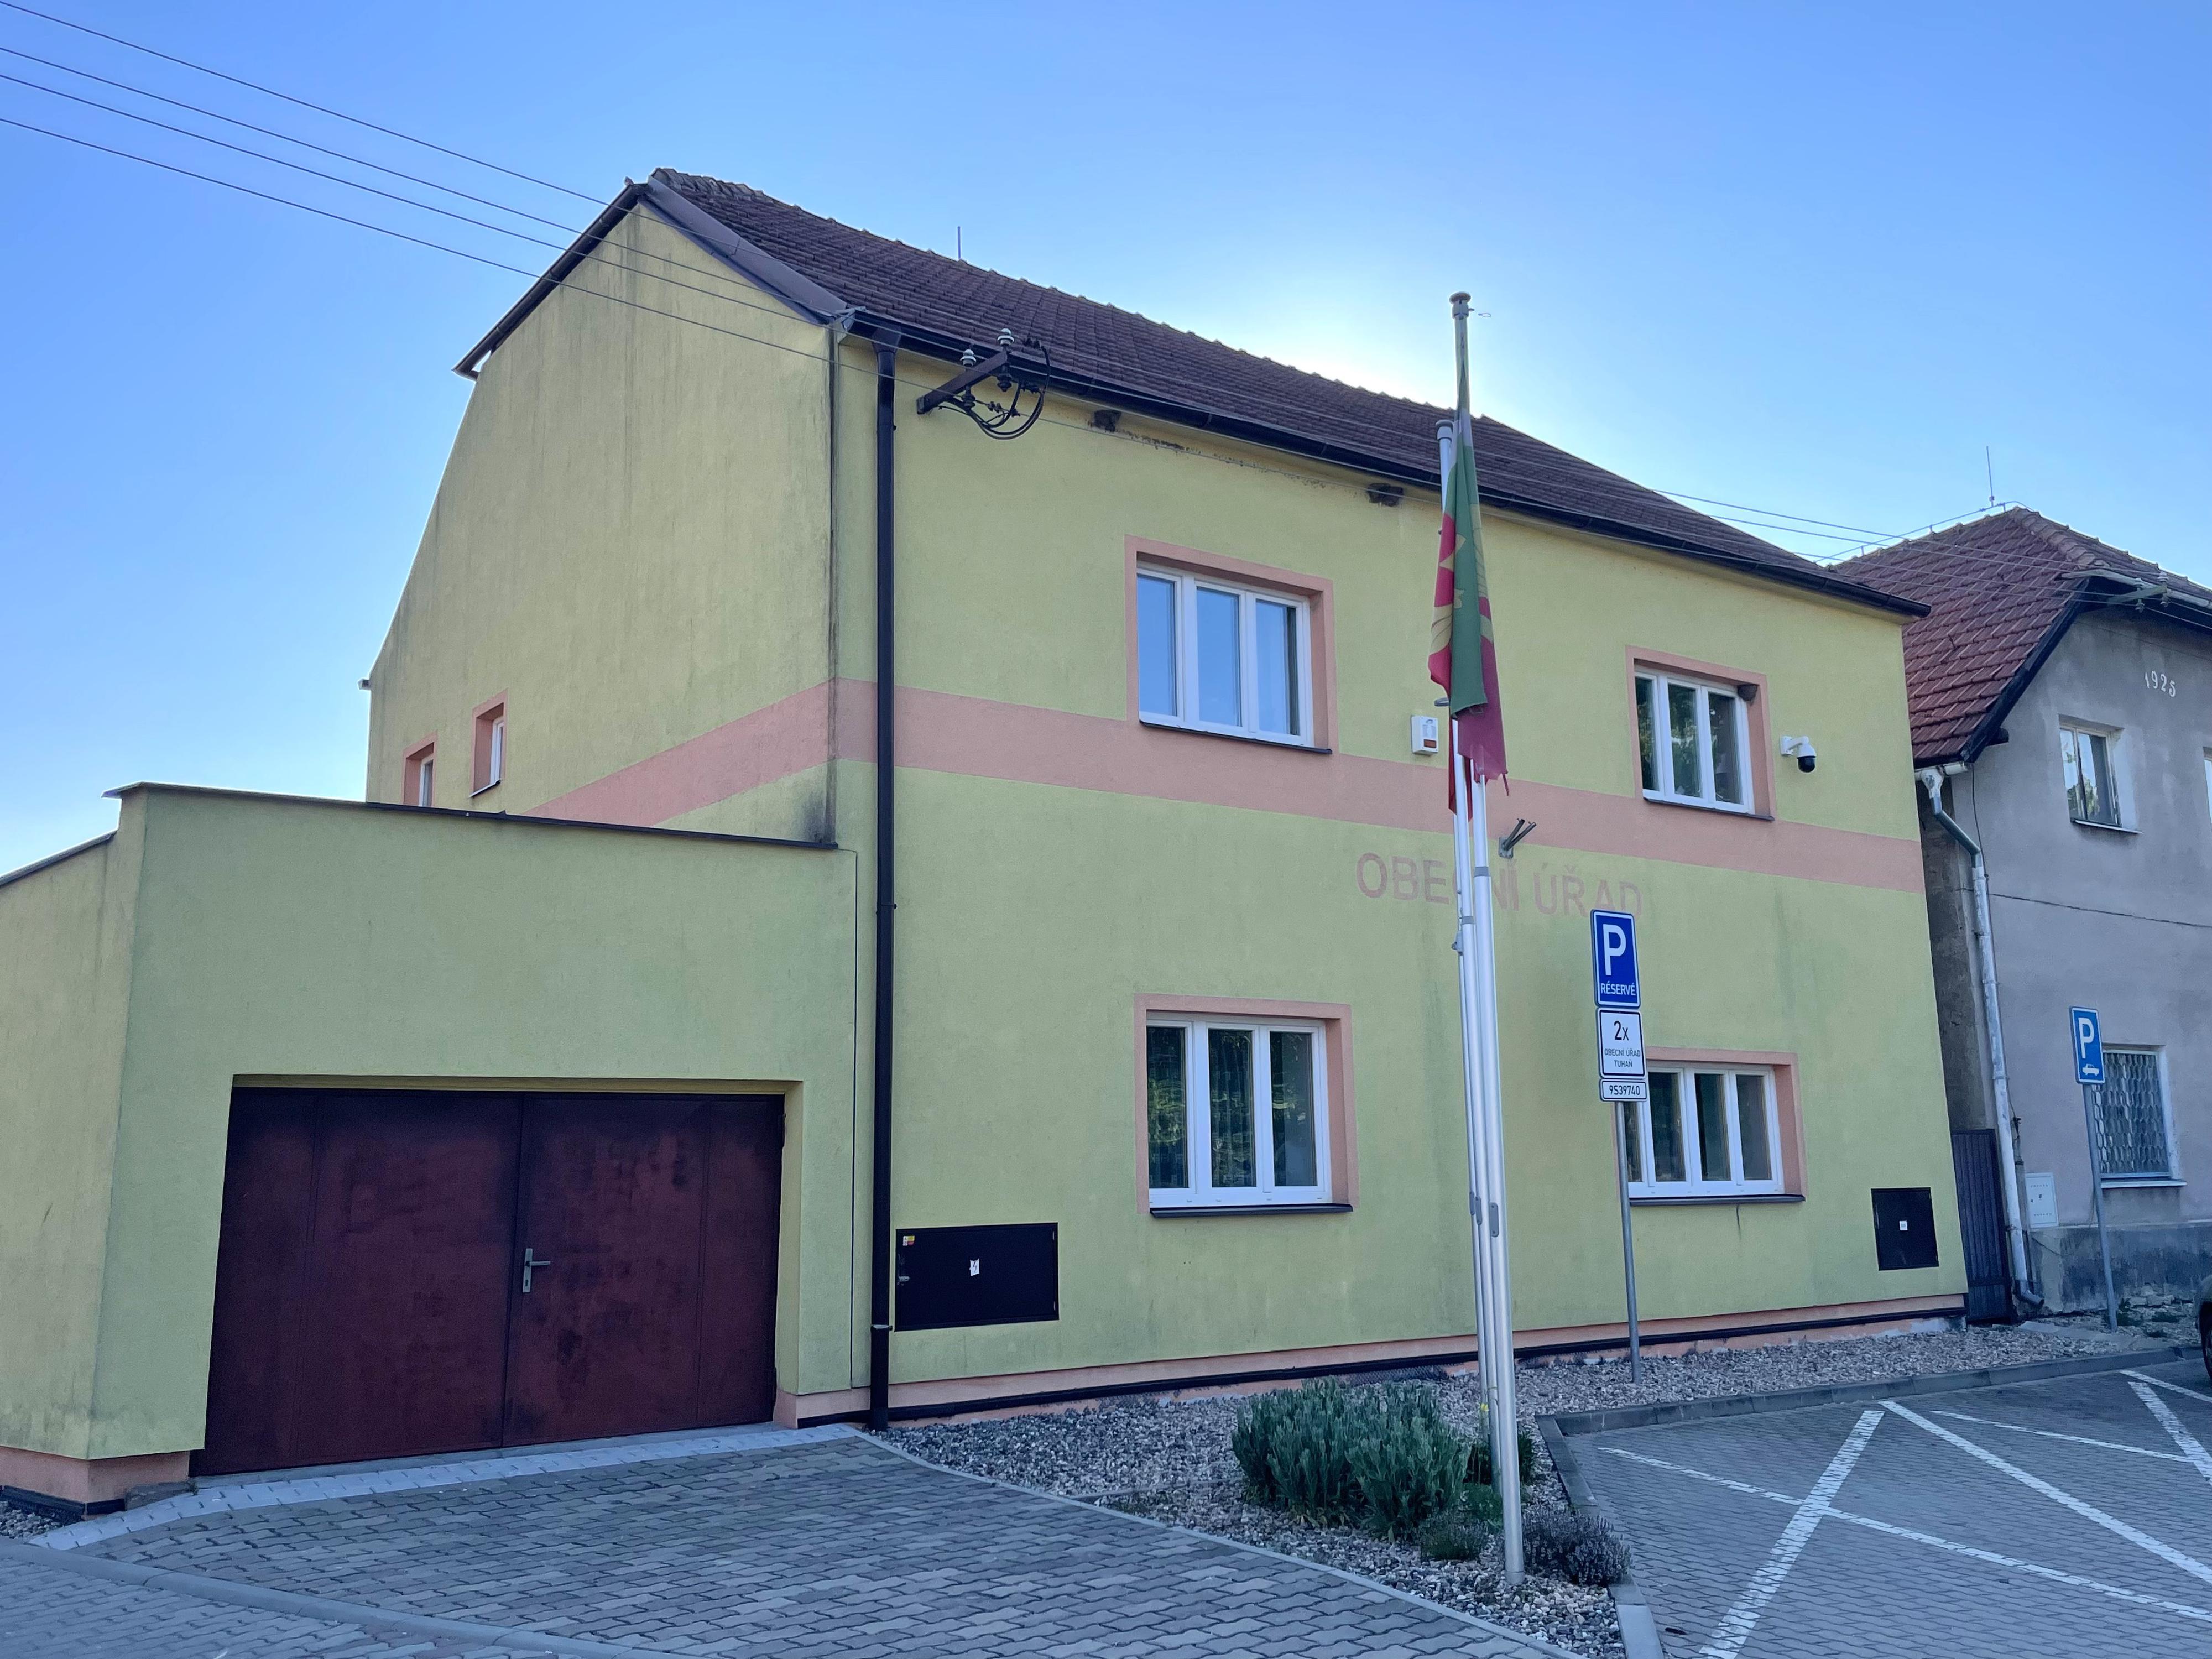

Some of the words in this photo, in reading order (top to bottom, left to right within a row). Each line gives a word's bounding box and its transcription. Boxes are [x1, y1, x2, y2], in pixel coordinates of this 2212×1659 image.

[2144, 670, 2176, 697] 1925
[1356, 852, 1520, 912] OBENÍ
[1603, 924, 1626, 976] P
[1600, 980, 1636, 996] RÉSERVÉ
[2078, 1017, 2095, 1059] P
[1604, 1048, 1625, 1056] OBECNÍ
[1626, 1048, 1641, 1057] ÚŘAD
[1614, 1058, 1633, 1068] TUHAŇ
[1609, 1085, 1640, 1095] 9S39740
